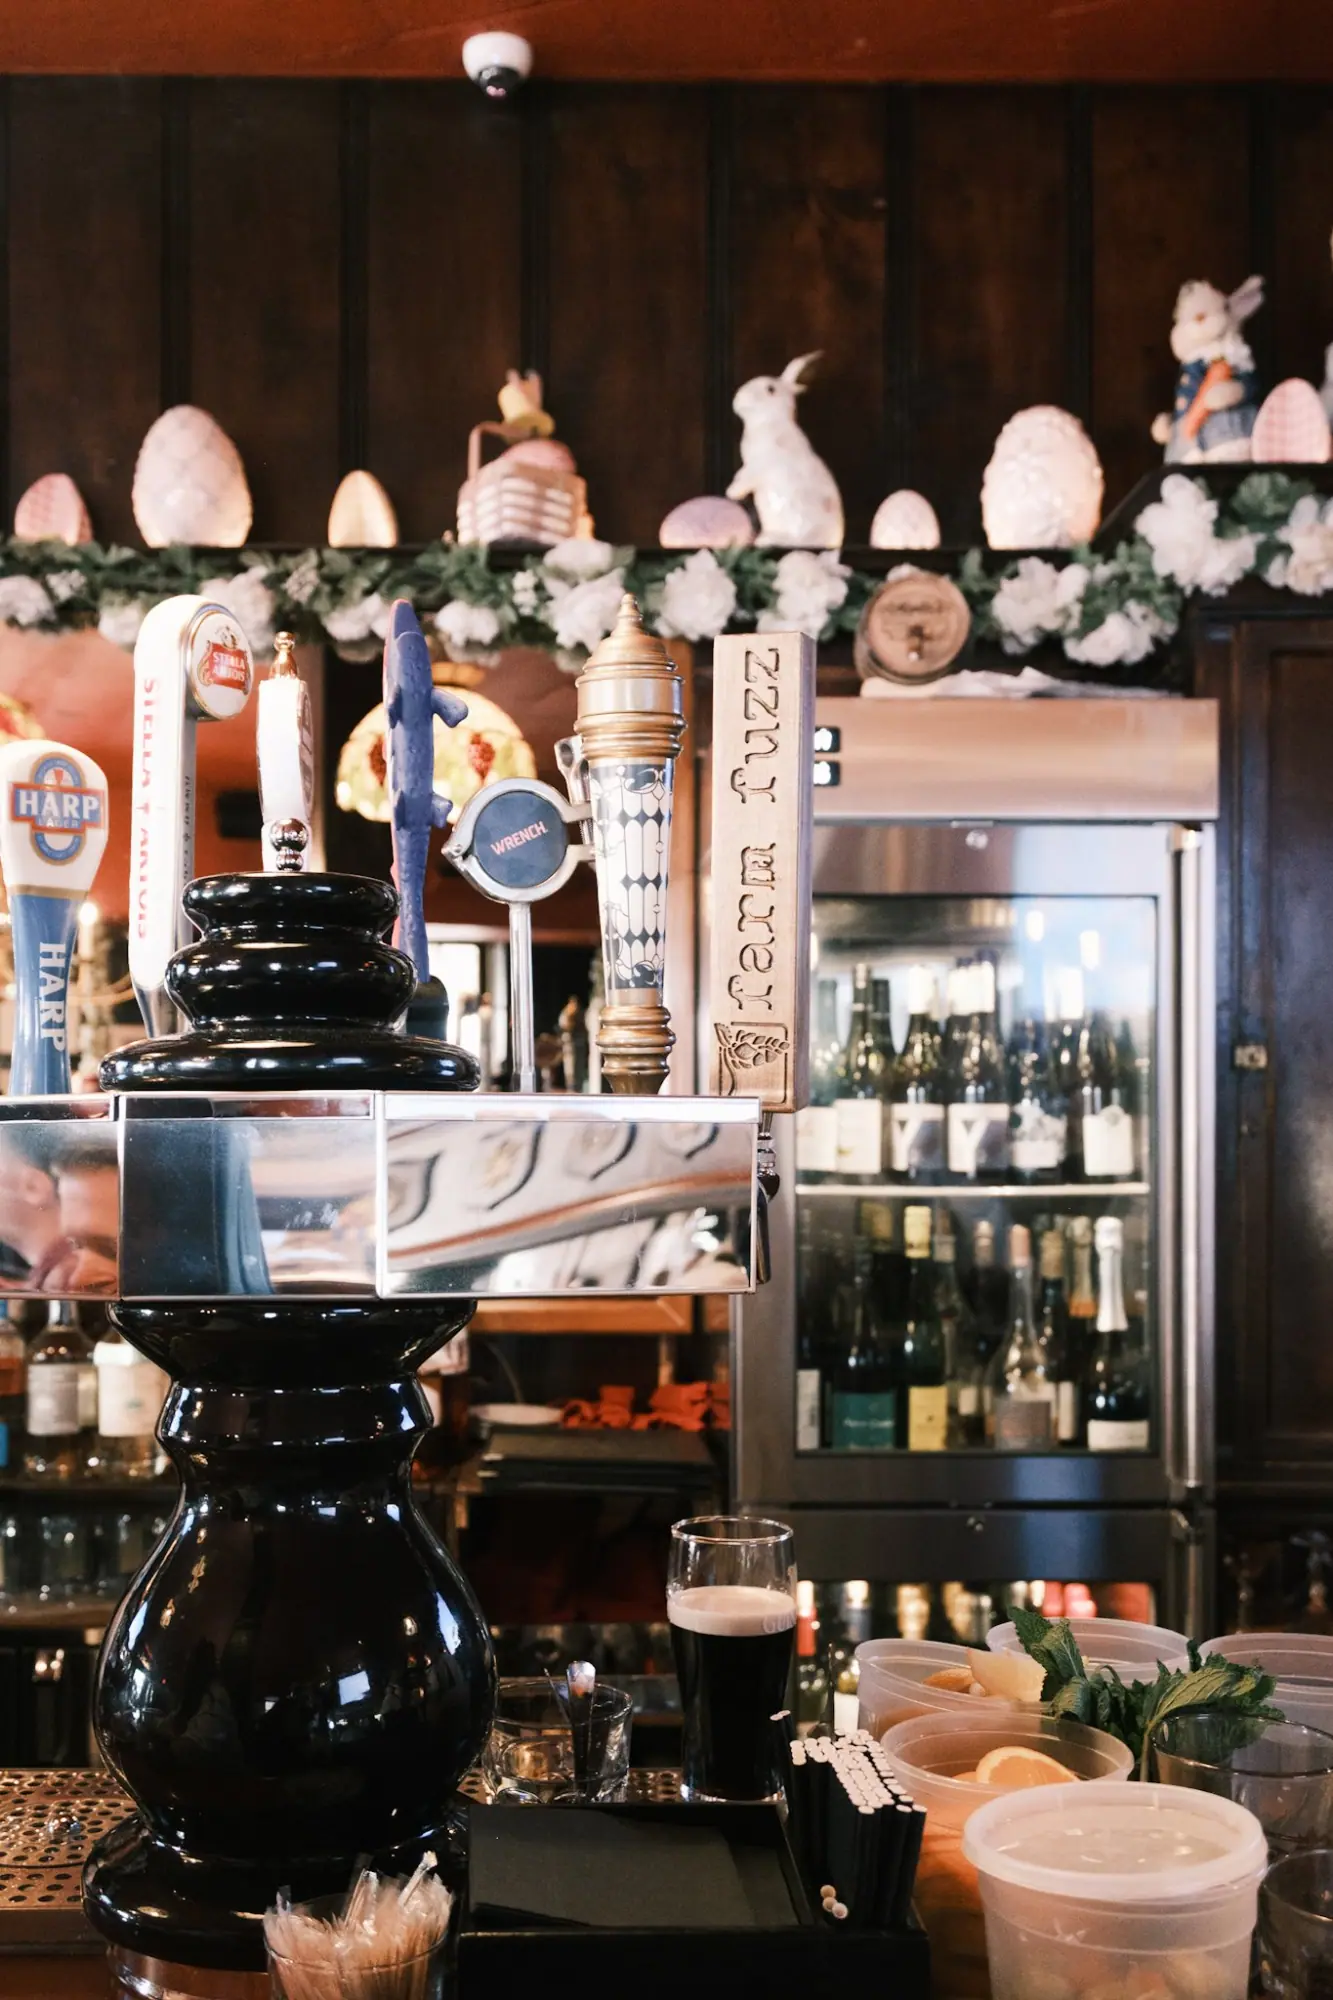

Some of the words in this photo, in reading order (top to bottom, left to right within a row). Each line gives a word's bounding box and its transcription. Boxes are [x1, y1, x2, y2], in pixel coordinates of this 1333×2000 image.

[729, 647, 781, 805] fuzz
[18, 788, 100, 820] HARP
[490, 820, 546, 856] WRENCH
[727, 842, 777, 1011] farm
[40, 941, 66, 1052] HARP
